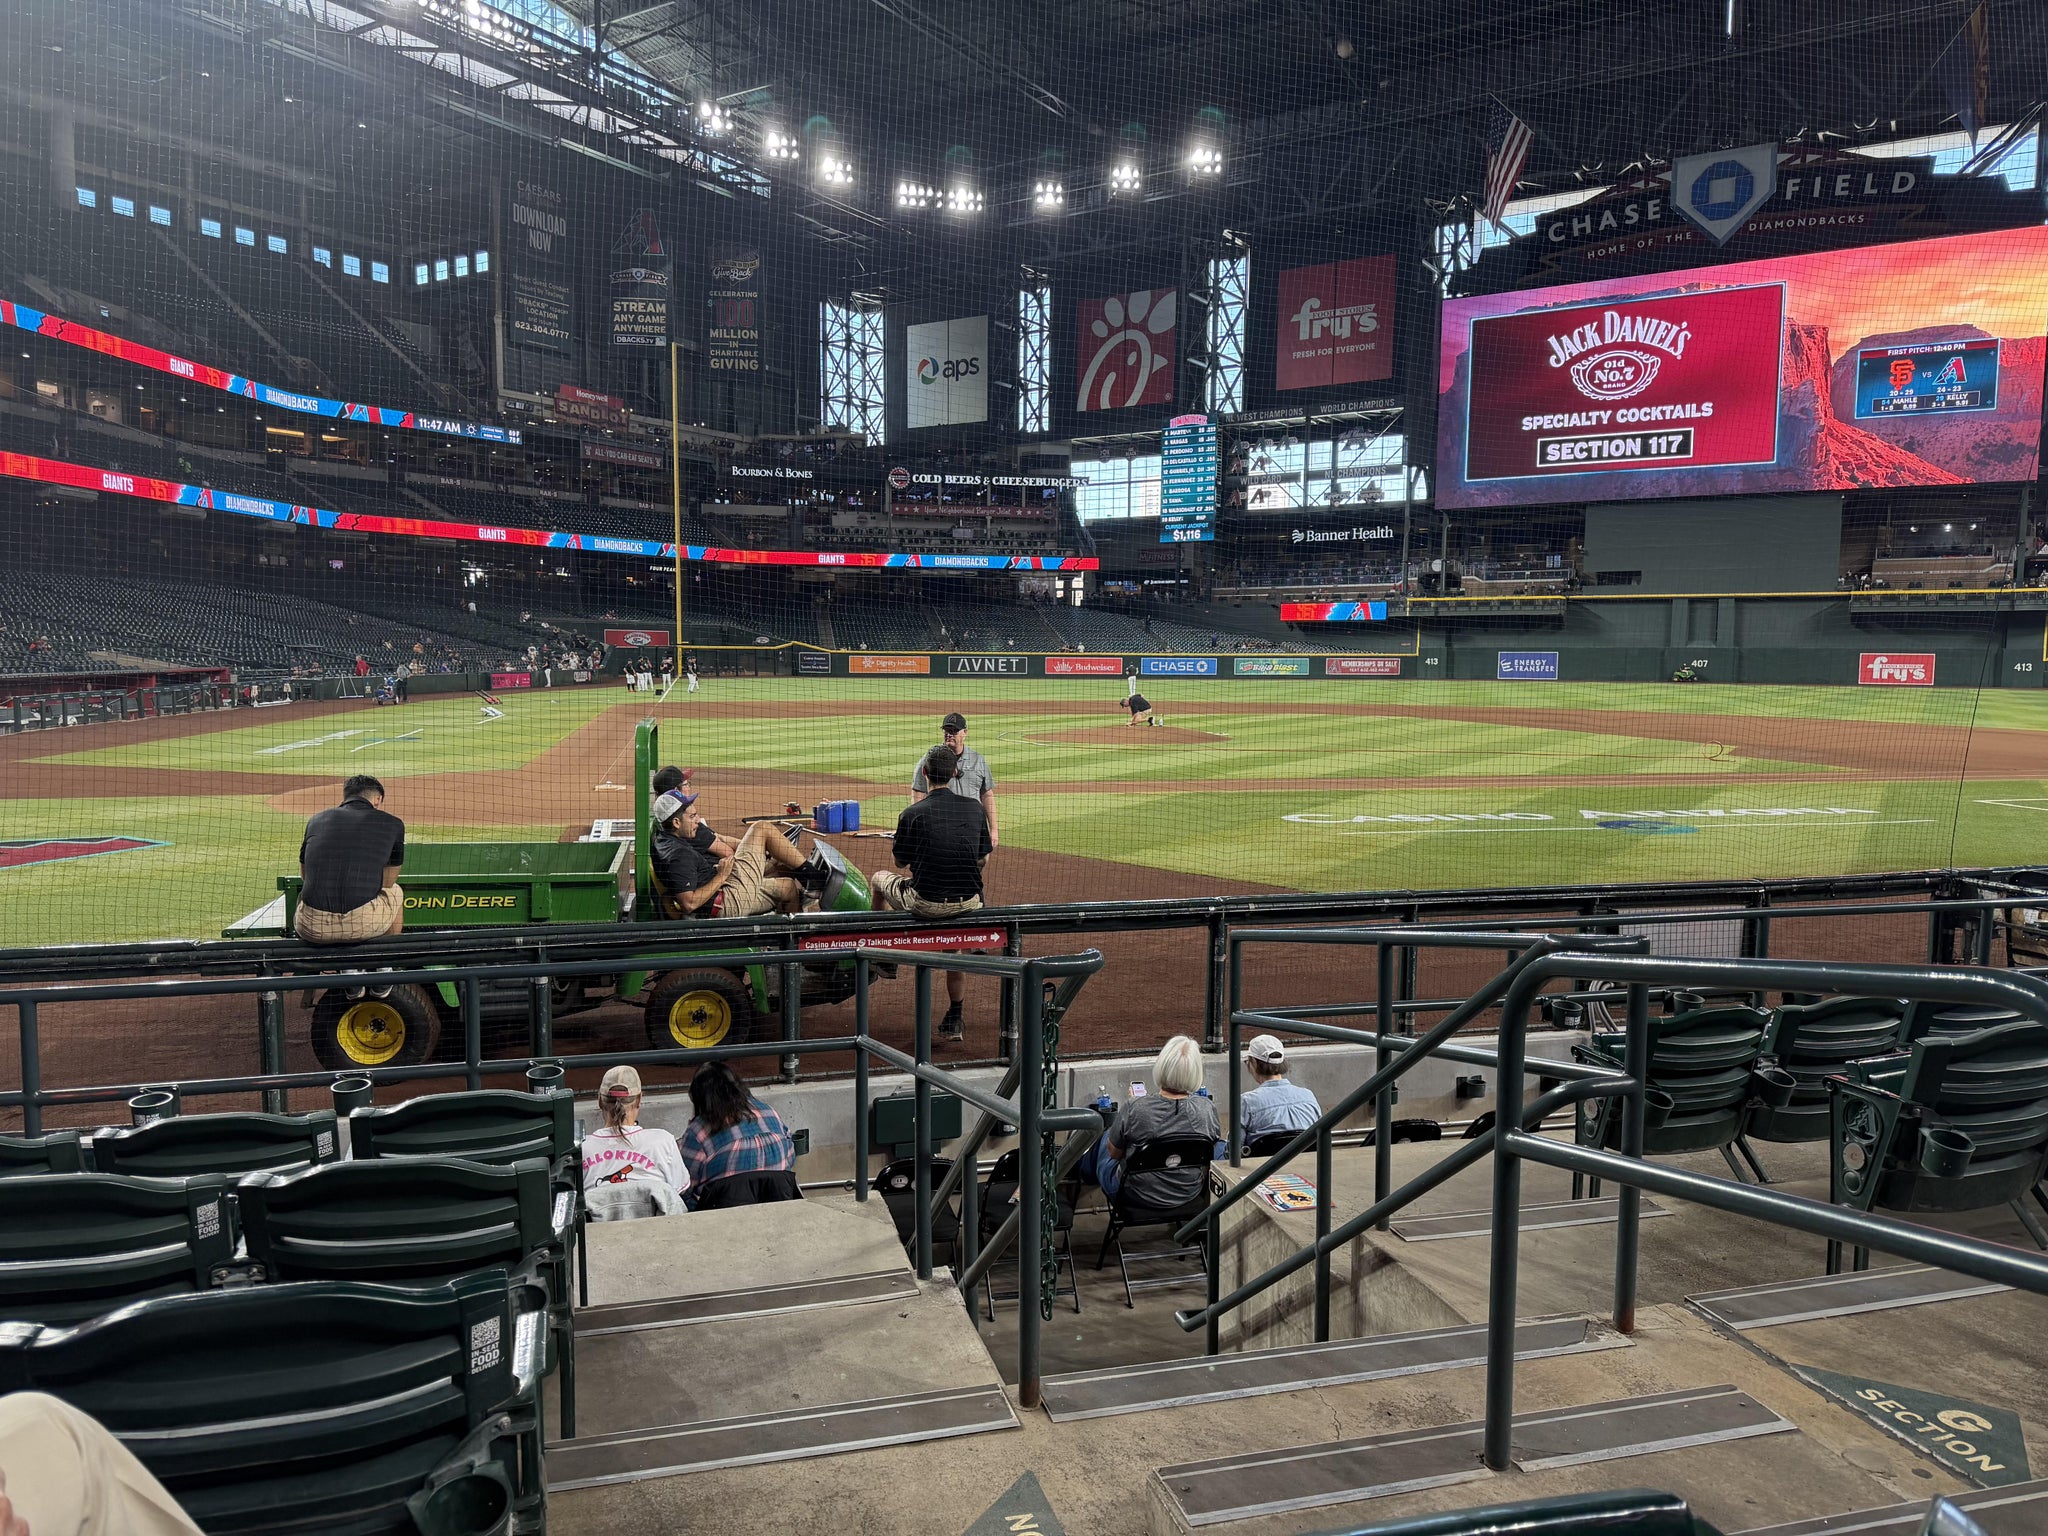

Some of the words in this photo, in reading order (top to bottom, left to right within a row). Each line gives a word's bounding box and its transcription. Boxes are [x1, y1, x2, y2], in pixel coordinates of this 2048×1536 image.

[517, 180, 561, 203] CAESARS
[1549, 199, 1661, 242] CHASE
[1786, 172, 1916, 200] FIELD
[513, 203, 566, 237] DOWNLOAD
[529, 228, 552, 253] NOW
[1587, 244, 1626, 259] HOME
[1637, 239, 1653, 249] OF
[1665, 232, 1692, 243] THE
[1749, 214, 1865, 232] DIAMONDBACKS
[709, 290, 758, 298] CELEBRATING
[527, 307, 558, 320] LOCATION
[613, 301, 666, 314] STREAM
[1339, 304, 1373, 315] STORES
[613, 314, 635, 322] ANY
[637, 315, 666, 324] GAME
[1290, 297, 1377, 341] fry's
[515, 320, 569, 339] 623.304.0777
[613, 324, 666, 334] ANYWHERE
[709, 328, 758, 339] MILLION
[616, 336, 653, 344] DBACKS.TV
[1547, 321, 1603, 368] JACK
[1603, 311, 1692, 356] DANIEL'S
[710, 349, 759, 357] CHARITABLE
[1292, 350, 1315, 359] FRESH
[1317, 348, 1333, 356] FOR
[1336, 342, 1376, 353] EVERYONE
[1887, 348, 1908, 356] FIRST
[1908, 346, 1932, 355] PITCH:
[1933, 344, 1952, 352] 12:40
[170, 358, 194, 378] GIANTS
[710, 358, 759, 370] GIVING
[942, 357, 979, 381] aps
[1603, 359, 1625, 369] Old
[1594, 366, 1635, 384] No.7
[266, 388, 319, 412] DIAMONDBACKS
[576, 389, 608, 402] Honeywell
[1320, 403, 1346, 413] WORLD
[1348, 398, 1395, 410] CHAMPIONS
[559, 402, 627, 424] SANDLOT
[1225, 415, 1235, 423] NL
[1236, 412, 1258, 422] WEST
[1259, 407, 1304, 420] CHAMPIONS
[1521, 410, 1613, 431] SPECIALTY
[1616, 402, 1714, 423] COCKTAILS
[419, 418, 443, 430] 11:47
[444, 421, 461, 433] AM
[1546, 438, 1641, 461] SECTION
[1648, 435, 1683, 454] 117
[732, 465, 773, 477] BOURBON
[774, 467, 783, 478] &
[786, 468, 813, 479] BONES
[1324, 470, 1335, 479] NL
[1337, 466, 1387, 478] CHAMPIONS
[103, 473, 134, 493] GIANTS
[440, 477, 461, 486] BAR-S
[912, 473, 942, 484] COLD
[944, 475, 981, 485] BEERS
[983, 477, 990, 485] &
[992, 477, 1089, 487] CHEESEBURGERS
[1240, 476, 1259, 485] WILD
[1261, 474, 1282, 484] CARD
[225, 495, 275, 516] DIAMONDBACKS
[478, 527, 506, 541] GIANTS
[1173, 529, 1201, 541] $1,116
[1306, 530, 1350, 542] Banner
[1351, 526, 1394, 540] Health
[594, 538, 643, 553] DIAMONDBACKS
[818, 554, 845, 564] GIANTS
[934, 556, 989, 567] DIAMONDBACKS
[957, 658, 1019, 672] AVNET
[1075, 663, 1115, 671] Budweiser
[1150, 661, 1194, 672] CHASE
[1691, 659, 1709, 668] 407
[1867, 656, 1926, 682] fry's
[2013, 663, 2033, 672] 413
[1281, 811, 1554, 824] CASINO
[1579, 807, 1882, 820] ARIZONA
[403, 897, 446, 908] OHN
[450, 894, 517, 908] DEERE
[805, 941, 829, 949] Casino
[831, 939, 857, 948] Arizona
[867, 938, 892, 947] Talking
[893, 936, 911, 945] Stick
[912, 936, 935, 944] Resort
[936, 934, 962, 944] Player's
[963, 933, 987, 944] Lounge
[319, 1147, 333, 1156] FOOD
[198, 1218, 219, 1229] IN-SEAT
[199, 1223, 220, 1236] FOOD
[471, 1341, 500, 1359] IN-SEAT
[471, 1349, 500, 1368] FOOD
[471, 1359, 499, 1375] DELIVERY
[1936, 1409, 1993, 1433] G
[1855, 1388, 2006, 1472] SECTION
